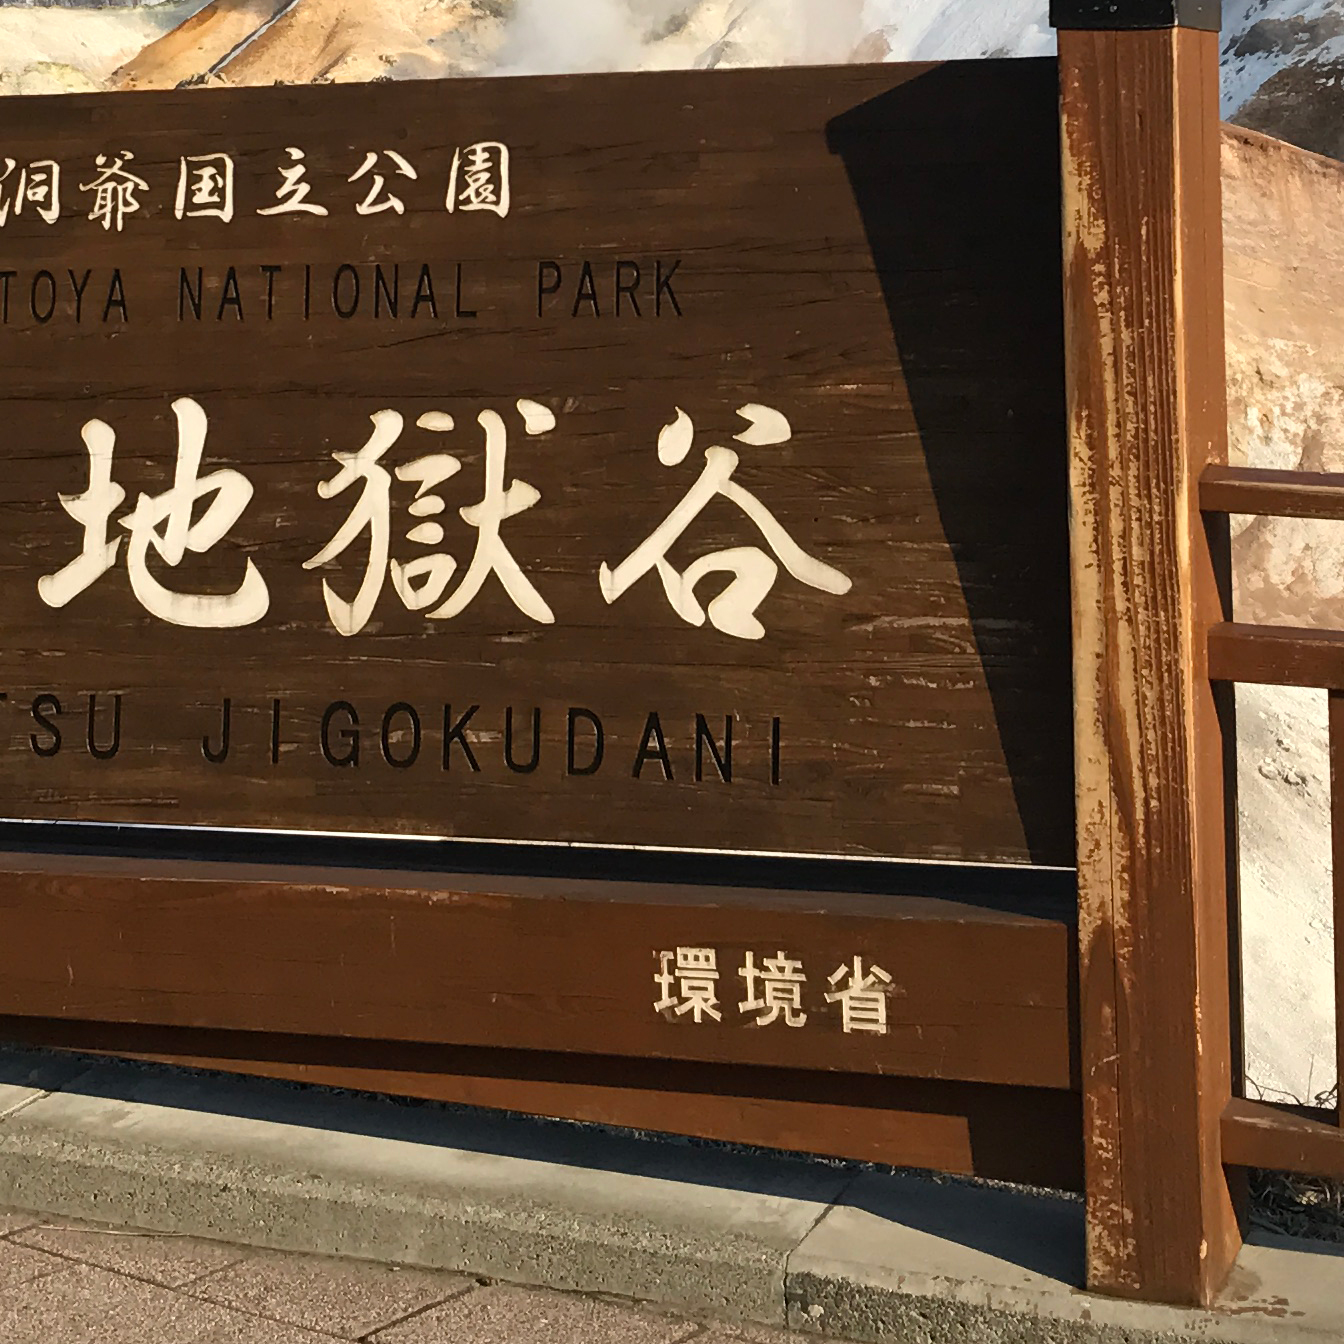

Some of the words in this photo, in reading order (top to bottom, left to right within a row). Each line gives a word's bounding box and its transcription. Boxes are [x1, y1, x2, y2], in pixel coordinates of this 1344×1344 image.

[176, 263, 479, 323] NATIONAL
[536, 258, 685, 320] PARK
[202, 697, 787, 787] JIGOKUDANI
[653, 946, 894, 1034] 環境省
